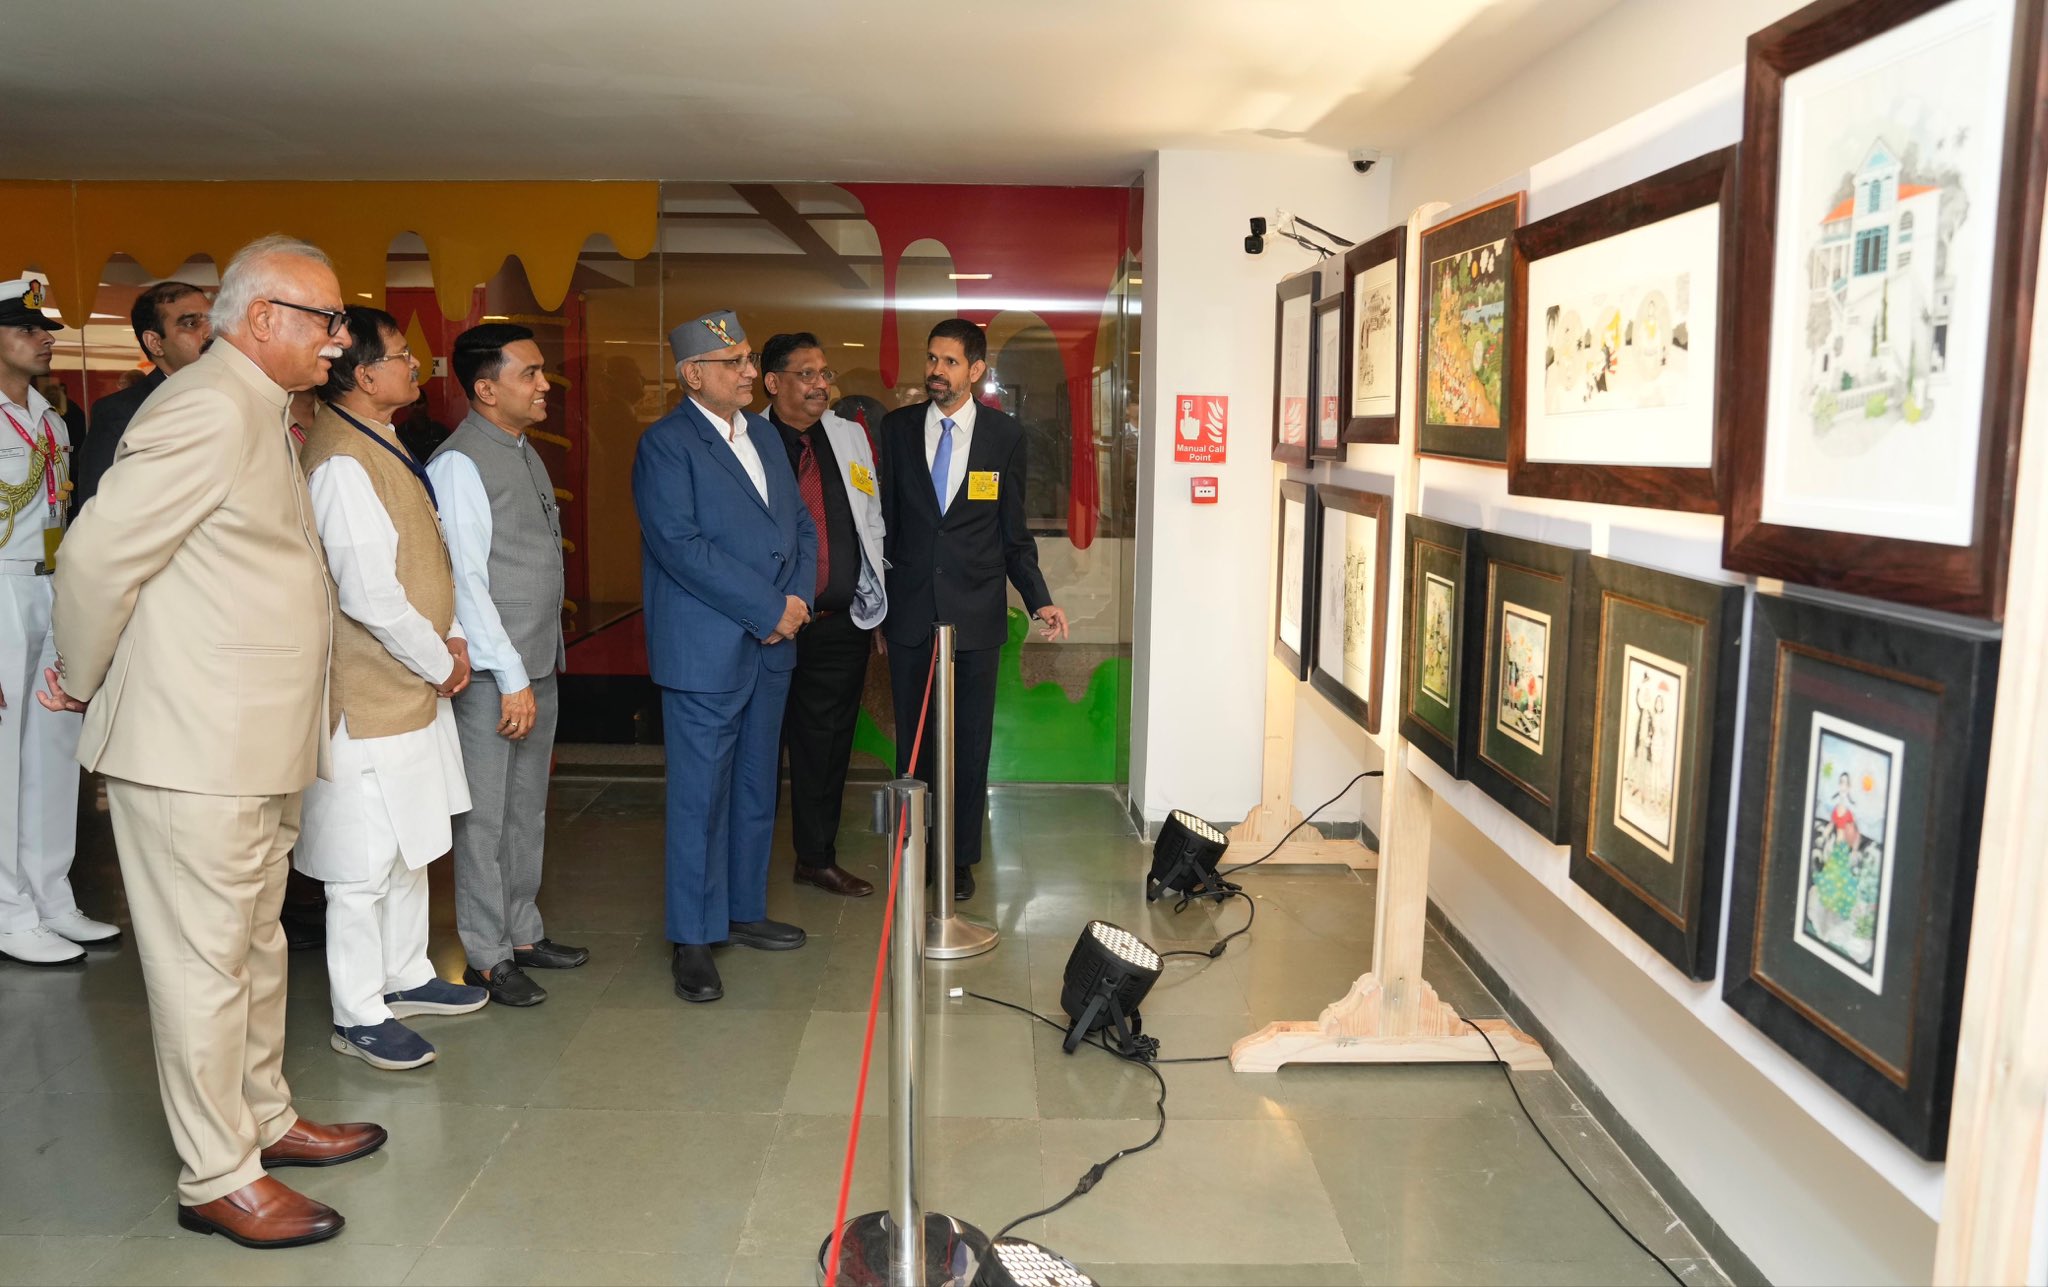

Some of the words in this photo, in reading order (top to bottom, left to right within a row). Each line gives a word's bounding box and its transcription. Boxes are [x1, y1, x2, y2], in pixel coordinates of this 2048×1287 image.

[1176, 444, 1207, 452] Manual
[1208, 445, 1225, 453] Call
[1189, 453, 1212, 461] Point
